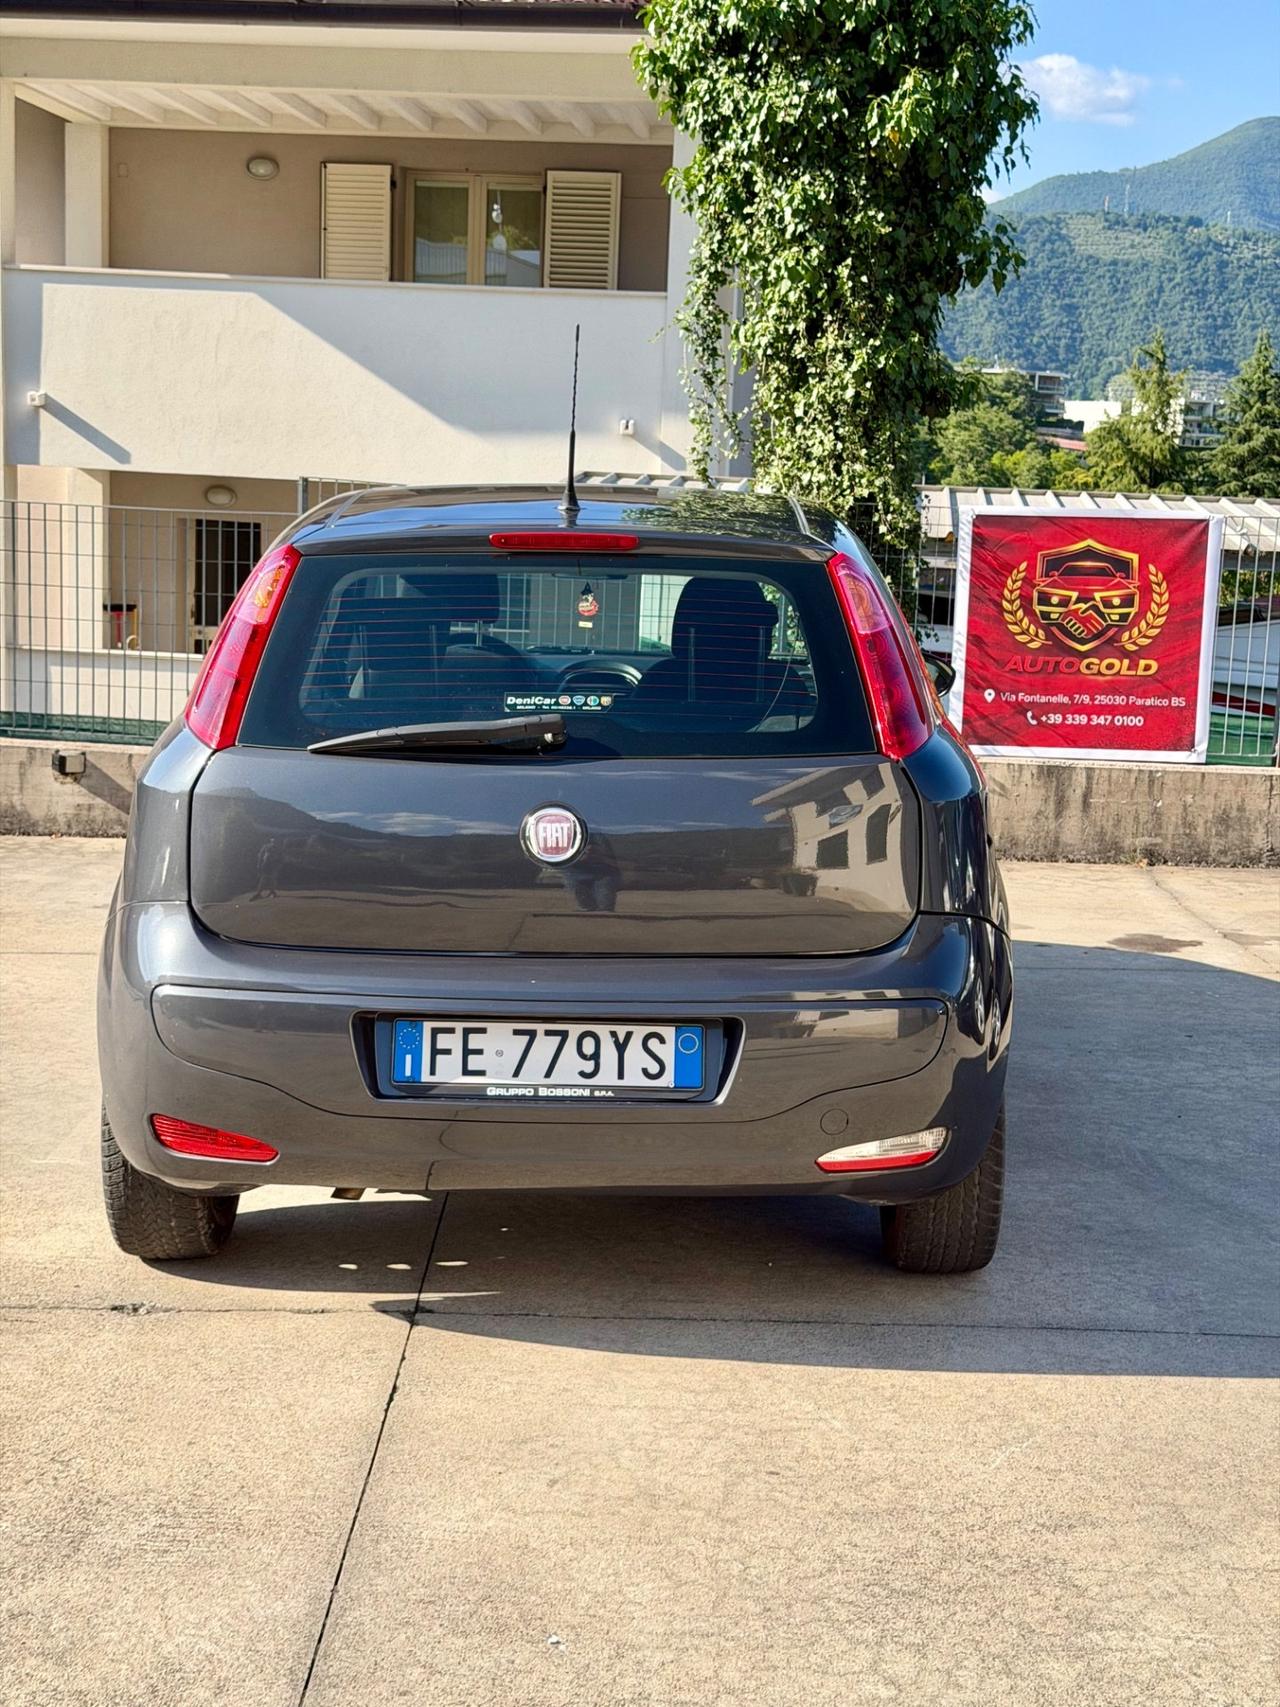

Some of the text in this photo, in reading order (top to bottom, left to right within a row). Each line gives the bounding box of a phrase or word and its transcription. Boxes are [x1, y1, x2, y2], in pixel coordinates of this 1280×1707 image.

[1005, 655, 1158, 676] AUTOGOLD
[507, 696, 556, 705] DeniCar
[1000, 692, 1186, 707] Via Fontanelle, 7/9, 25030 Paratico BS
[1040, 713, 1144, 726] +39 339 347 0100
[539, 822, 570, 848] FIAT
[429, 1027, 666, 1080] FE 779YS
[486, 1086, 534, 1096] GRUPPO
[538, 1087, 590, 1097] BOSSONI
